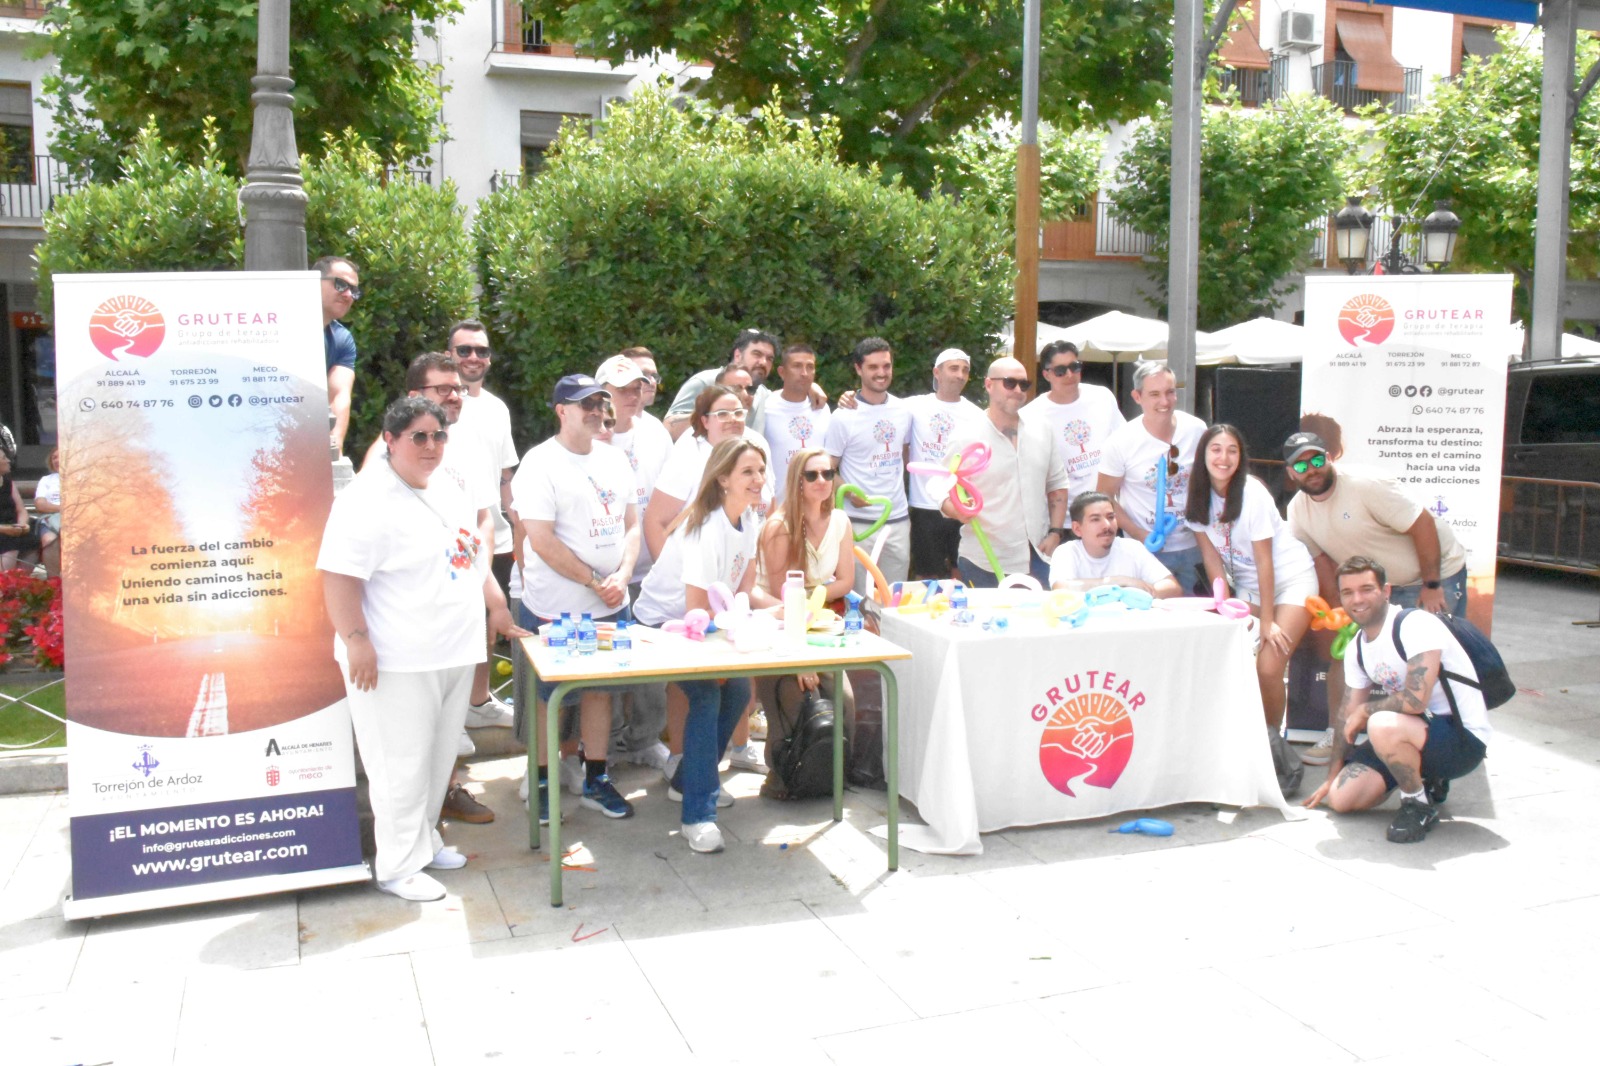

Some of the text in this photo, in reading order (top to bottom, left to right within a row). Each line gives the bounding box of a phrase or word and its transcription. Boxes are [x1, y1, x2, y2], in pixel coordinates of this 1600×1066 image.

[178, 312, 277, 326] GRUTEAR
[1404, 310, 1484, 320] GRUTEAR
[178, 328, 279, 338] Grupo de terapia
[105, 368, 140, 376] ALCALÁ
[170, 368, 217, 376] TORREJÓN
[1438, 387, 1484, 396] @grutear
[101, 400, 124, 409] 640
[126, 400, 140, 408] 74
[143, 400, 157, 408] 87
[248, 395, 304, 406] @grutear
[1441, 438, 1482, 446] destino:
[1068, 453, 1088, 465] PASEO
[1459, 464, 1480, 472] vida
[1425, 476, 1480, 484] adicciones
[1452, 519, 1477, 527] Ardoz
[590, 529, 599, 537] LA
[132, 539, 274, 555] La fuerza del cambio
[150, 555, 254, 570] comienza aquí:
[122, 570, 283, 589] Uniendo caminos hacia
[123, 588, 287, 606] una vida sin adicciones.
[1316, 672, 1326, 681] ¡E
[1031, 670, 1146, 722] GRUTEAR
[299, 772, 323, 780] meco
[92, 773, 202, 793] Torrejón de Ardoz
[109, 804, 324, 842] ¡EL MOMENTO ES AHORA!
[142, 828, 296, 853] info@grutearadicciones.com
[132, 844, 308, 876] www.grutear.com
